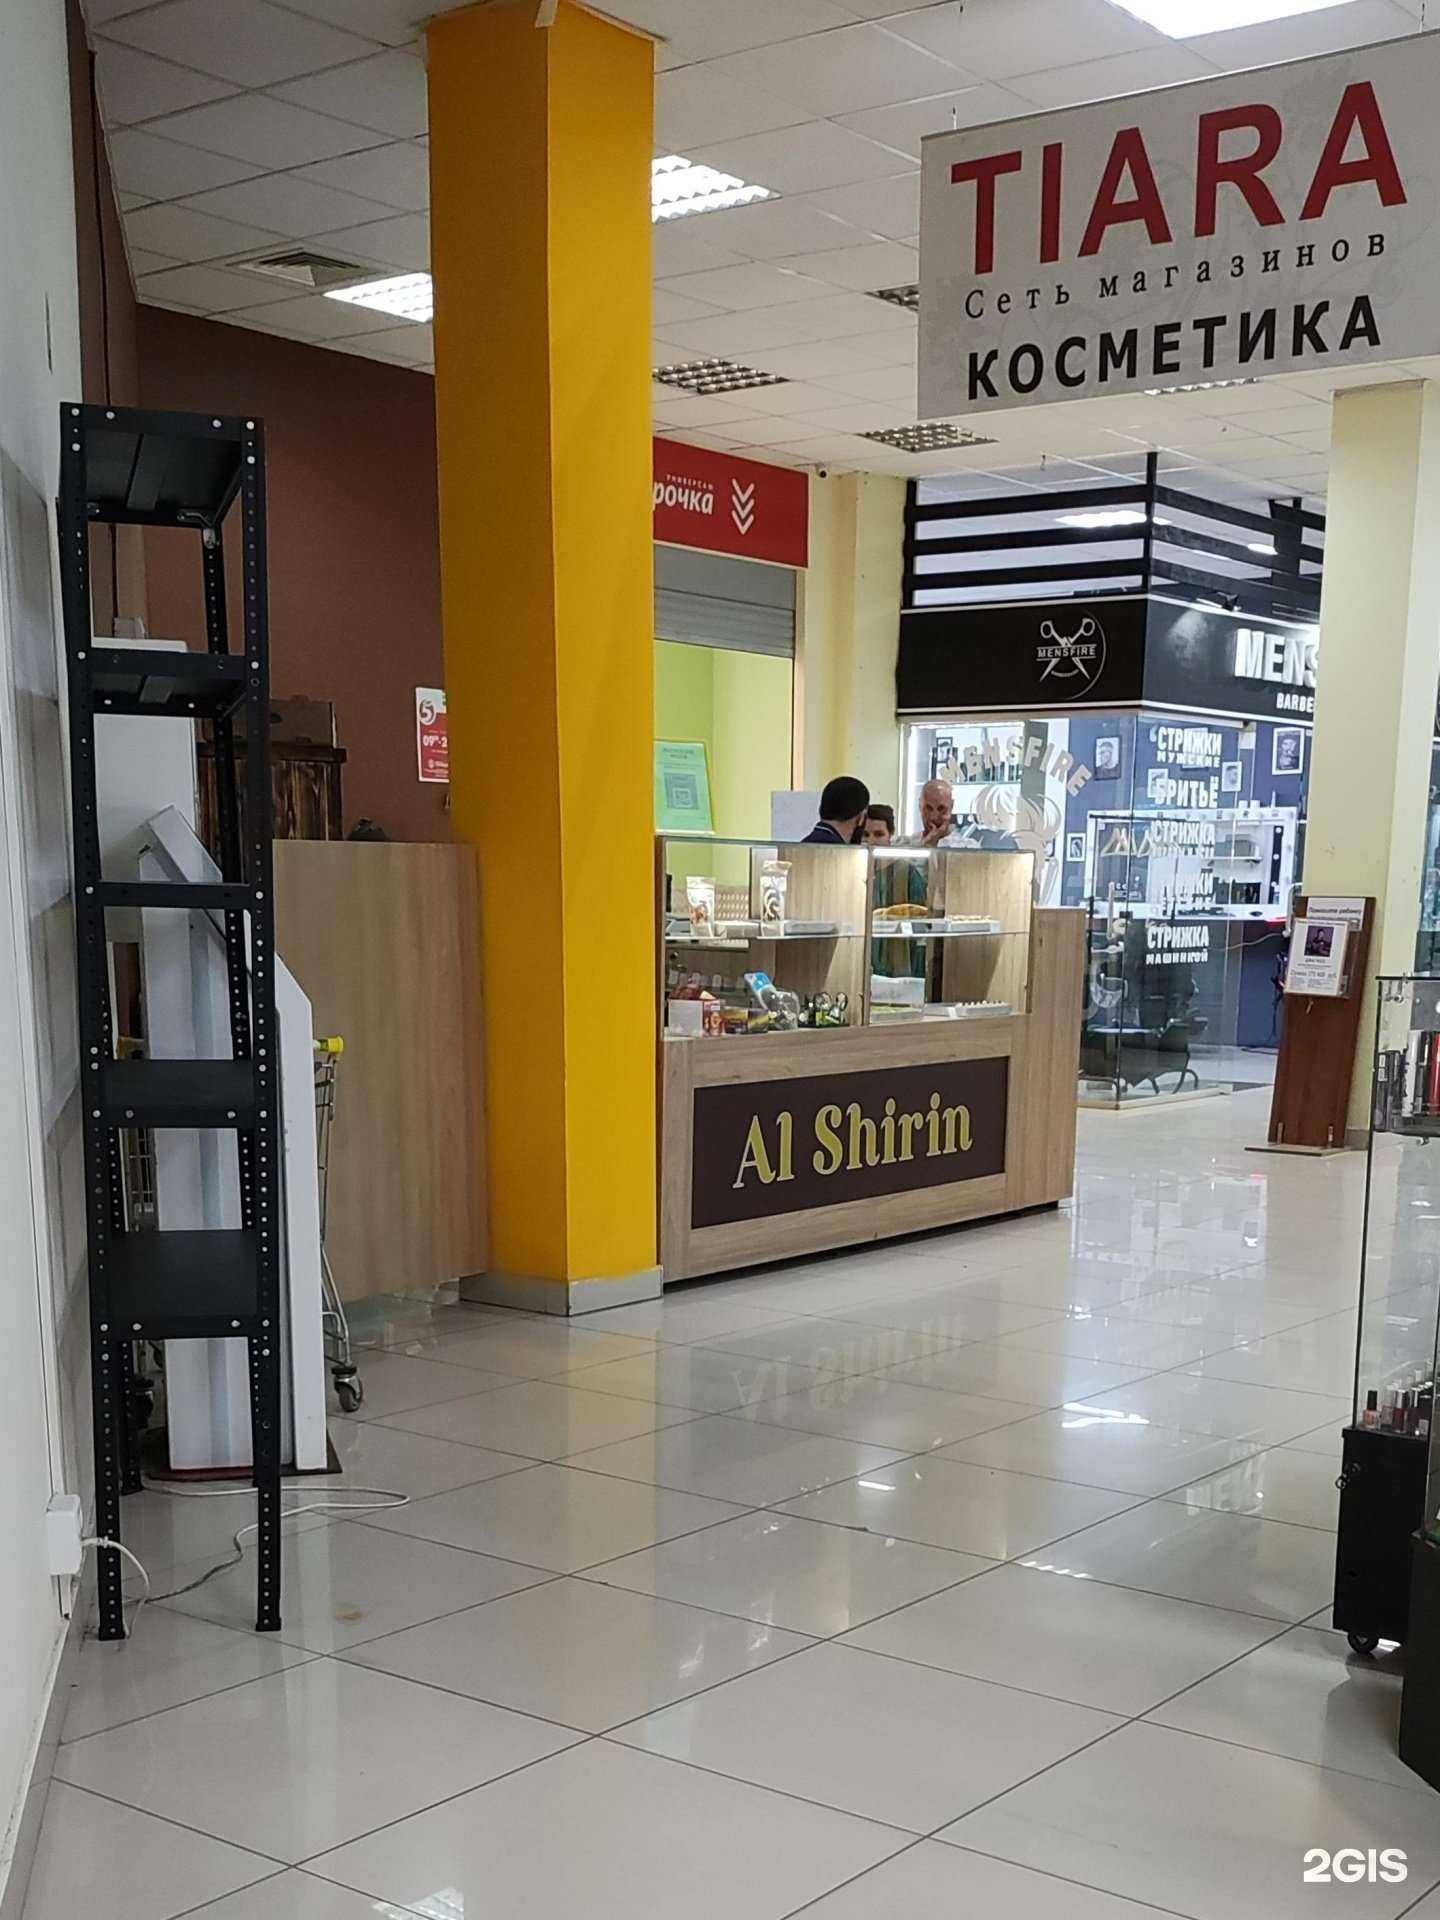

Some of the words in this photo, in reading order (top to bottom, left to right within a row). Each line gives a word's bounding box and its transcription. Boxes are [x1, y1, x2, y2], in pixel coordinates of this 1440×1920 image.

[951, 81, 1407, 275] TIARA
[965, 284, 1071, 319] Сеть
[1099, 234, 1385, 299] магазинов
[968, 296, 1381, 400] КОСМЕТИКА
[1037, 646, 1096, 658] MENSFIRE
[1157, 726, 1221, 755] СТРИЖКИ
[1157, 750, 1220, 768] МУЖСКИЕ
[1146, 925, 1209, 949] СТРИЖКА
[1146, 948, 1208, 965] МАШИНКОЙ
[732, 1111, 795, 1189] Al
[813, 1092, 973, 1175] Shirin
